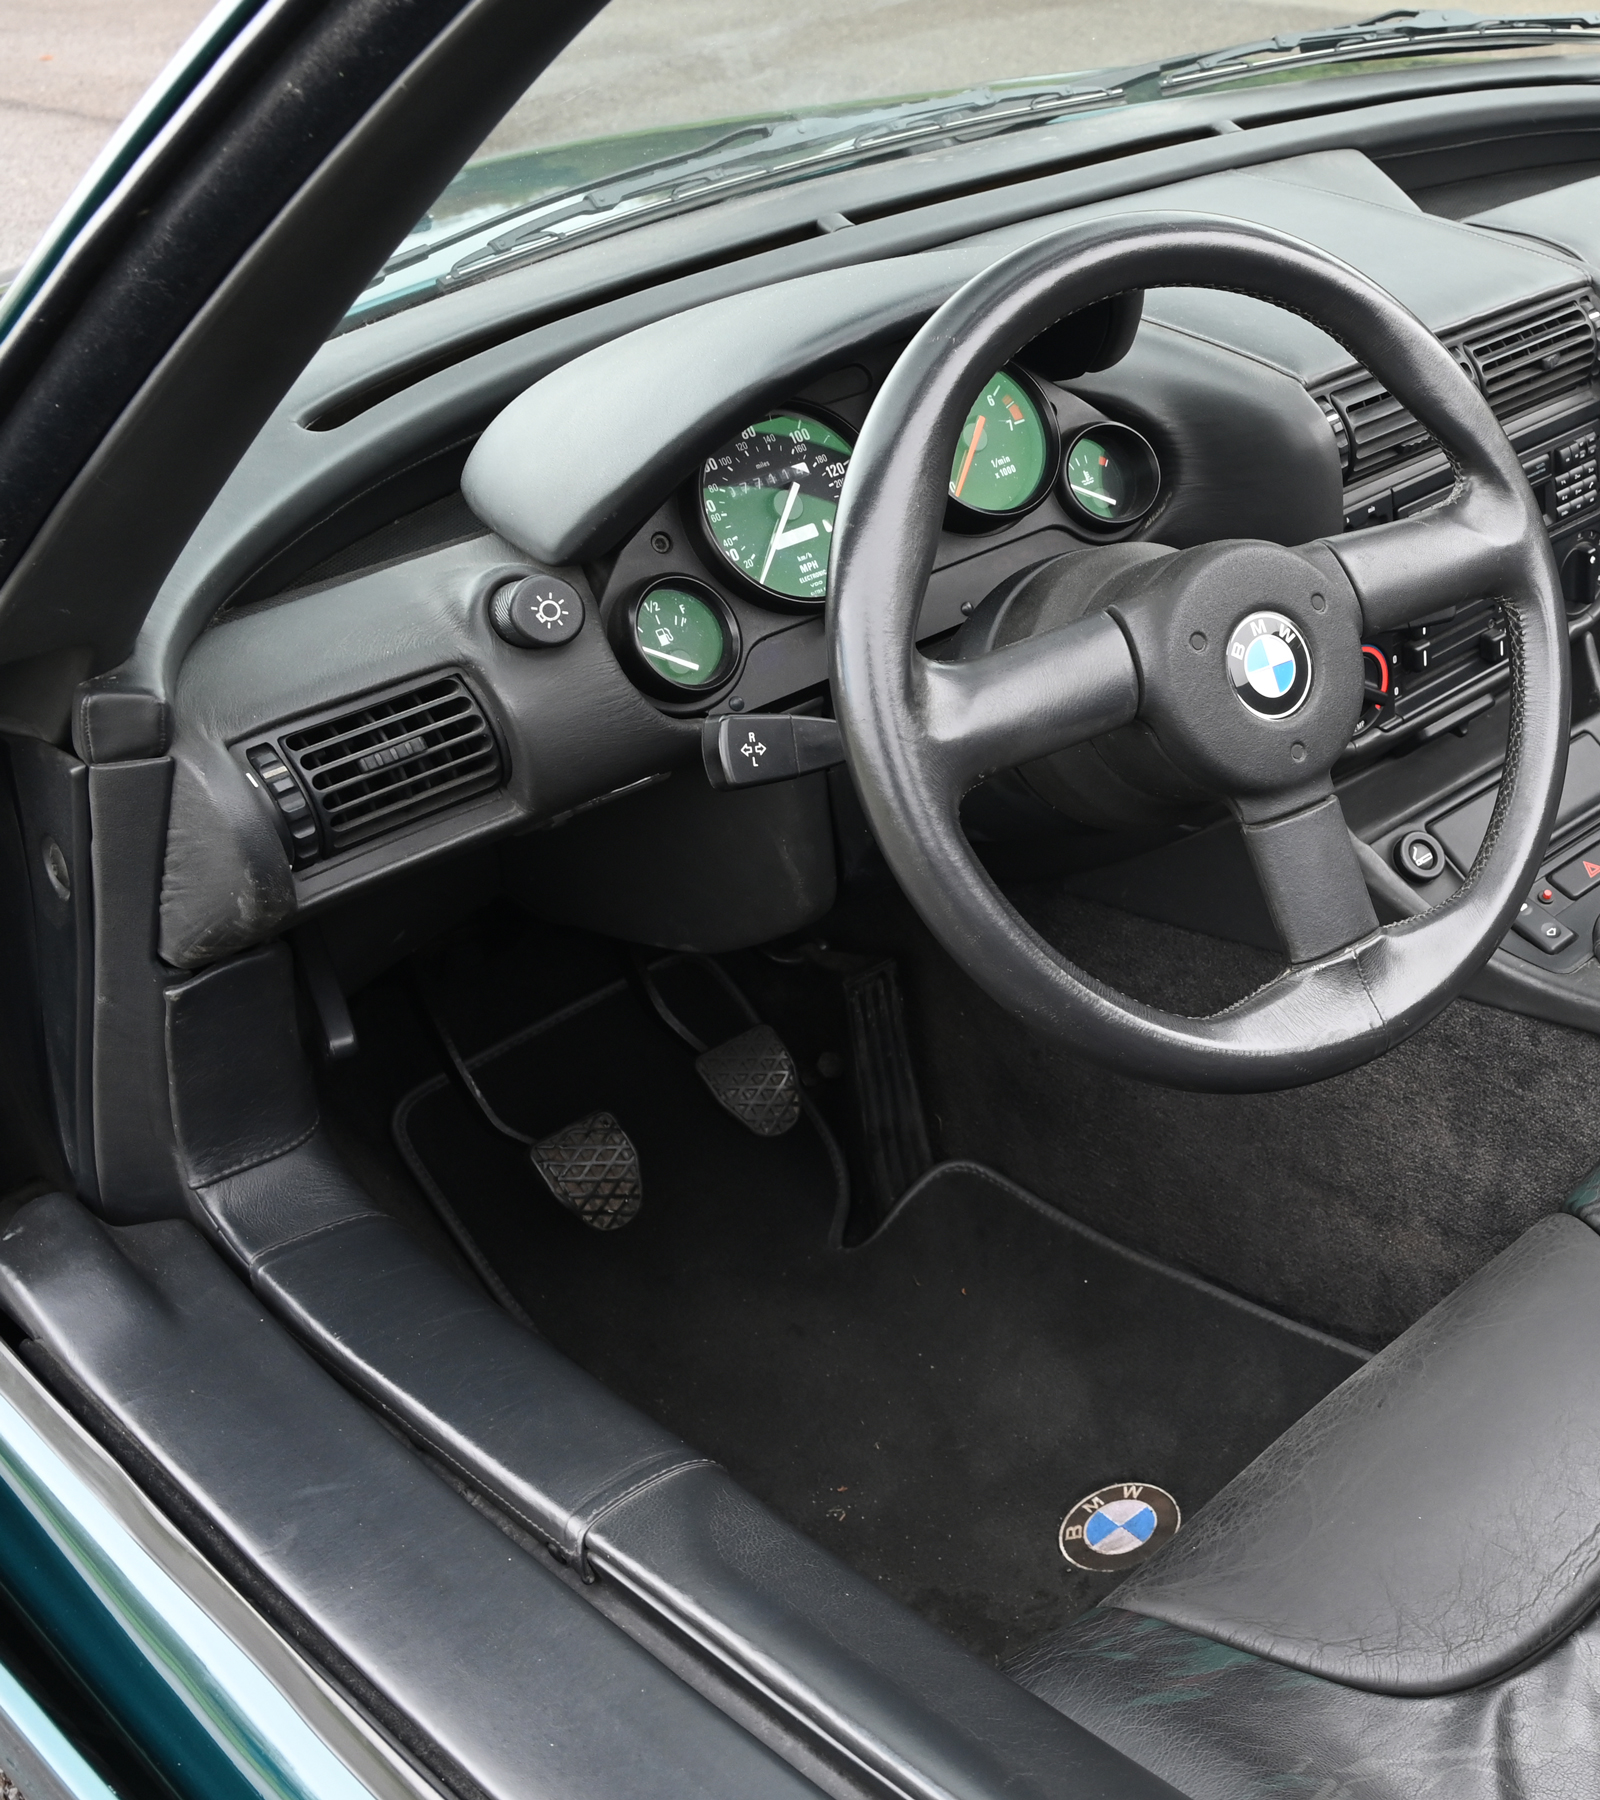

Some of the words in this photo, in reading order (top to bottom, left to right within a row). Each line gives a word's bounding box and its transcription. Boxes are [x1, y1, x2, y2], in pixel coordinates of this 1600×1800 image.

[987, 394, 995, 406] 6
[1006, 419, 1014, 431] 7
[763, 434, 776, 444] 140
[789, 428, 810, 444] 100
[736, 442, 748, 452] 120
[794, 444, 807, 453] 160
[718, 456, 732, 466] 100
[756, 461, 770, 470] miles
[990, 456, 1010, 468] 1/min
[826, 462, 846, 478] 120
[1000, 464, 1016, 476] 1000
[708, 483, 718, 493] 80
[710, 513, 722, 522] 60
[723, 538, 734, 547] 40
[743, 558, 754, 568] 20
[799, 560, 819, 574] MPH
[644, 600, 660, 614] 1/2
[679, 604, 686, 614] F
[1230, 618, 1296, 660] BMW
[748, 732, 756, 742] R
[752, 756, 758, 767] L
[1065, 1485, 1143, 1541] BMW
